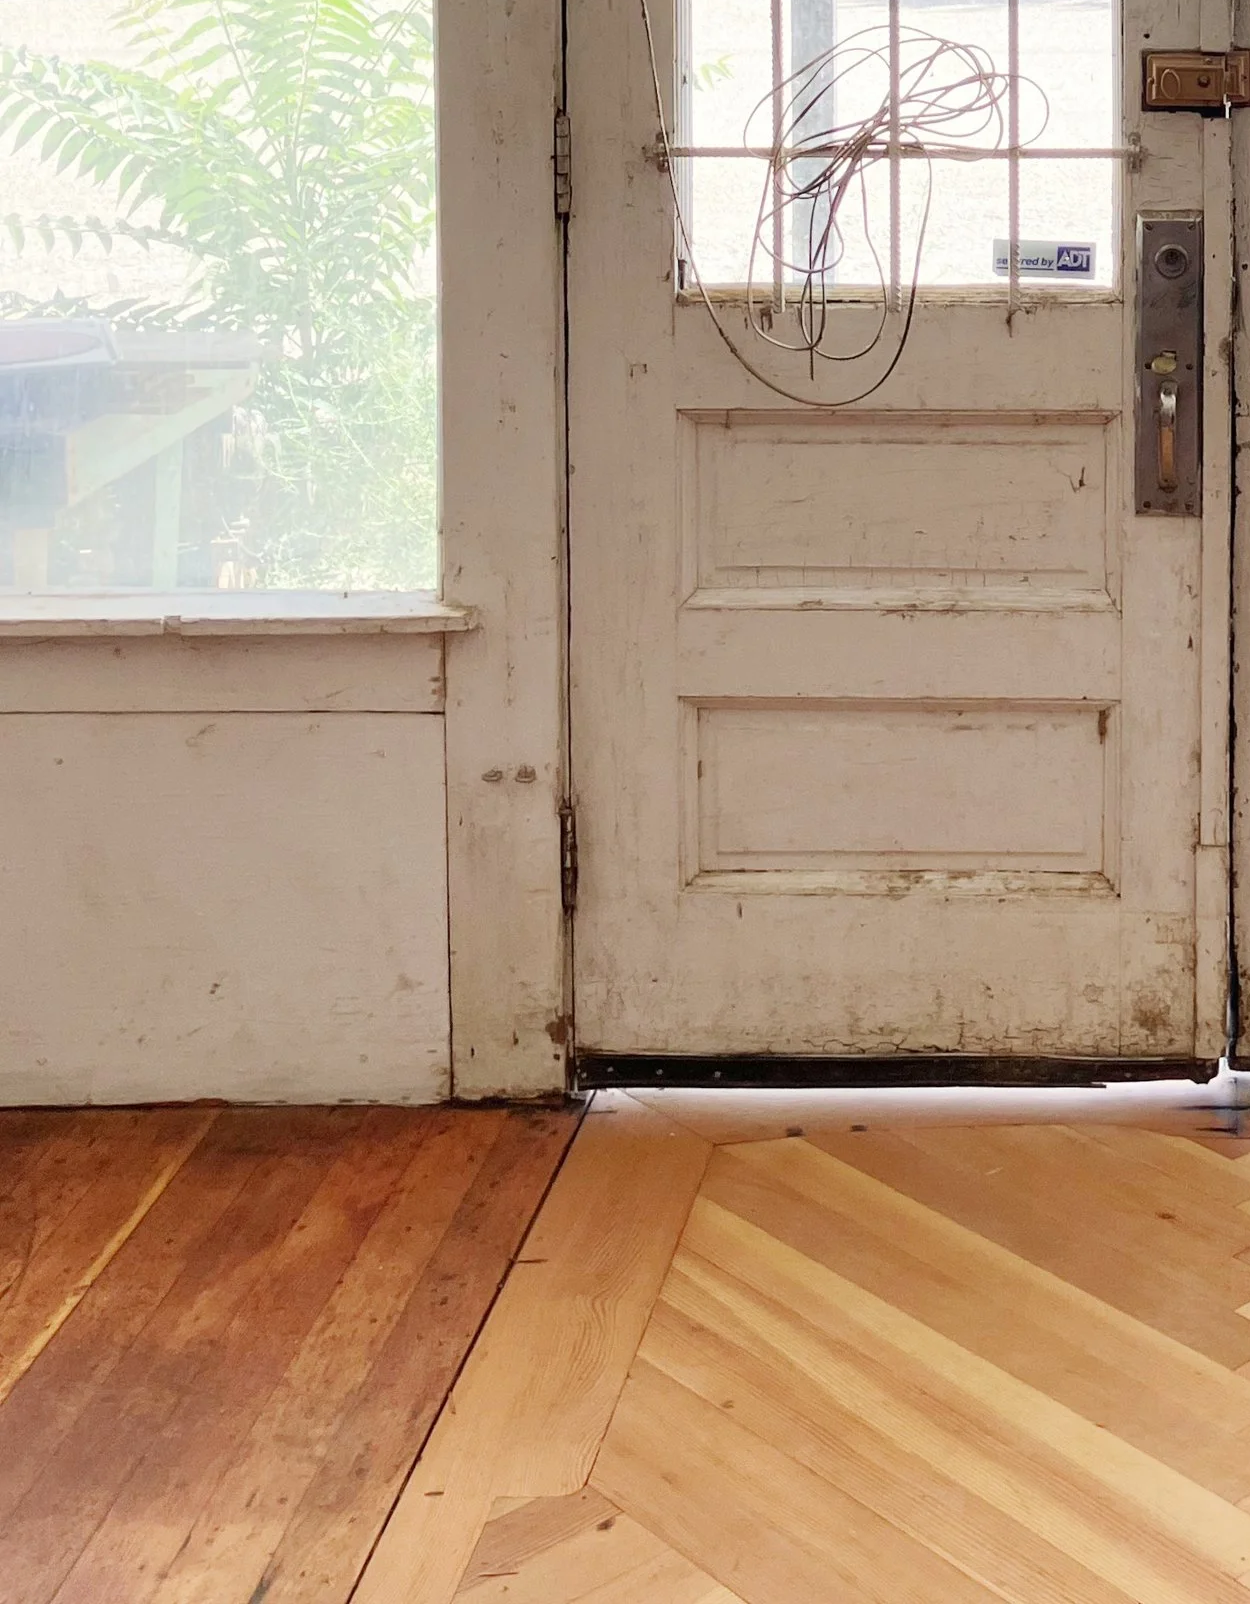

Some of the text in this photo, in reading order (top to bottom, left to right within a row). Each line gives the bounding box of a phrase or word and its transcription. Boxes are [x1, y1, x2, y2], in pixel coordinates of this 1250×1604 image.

[996, 249, 1090, 269] sered by ADT
